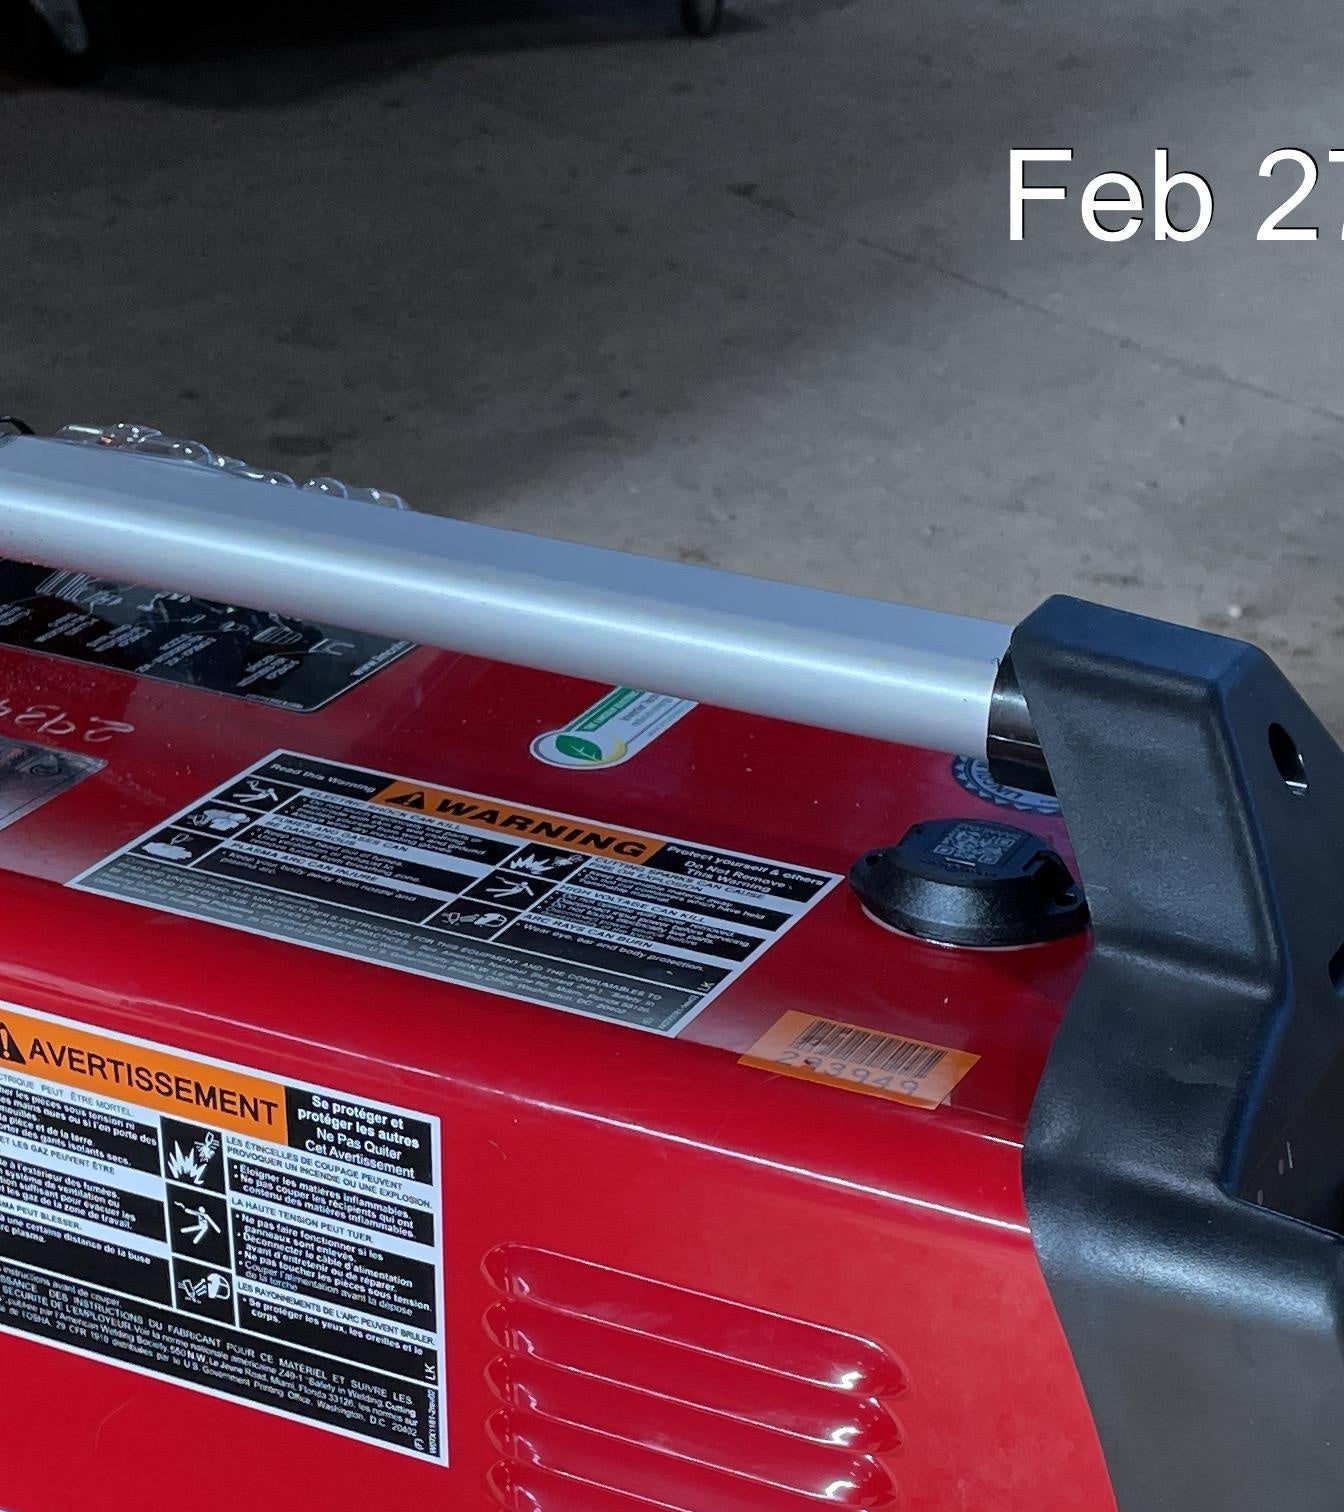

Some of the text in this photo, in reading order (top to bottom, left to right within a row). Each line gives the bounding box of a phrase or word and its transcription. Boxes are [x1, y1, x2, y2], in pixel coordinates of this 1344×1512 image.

[429, 798, 652, 857] WARNING
[712, 856, 769, 874] yourself
[713, 875, 772, 893] Warning
[730, 871, 788, 888] Remove
[26, 1035, 279, 1128] AVERTISSEMENT
[297, 1105, 419, 1149] protéger les autres
[332, 1100, 387, 1128] protéger
[316, 1126, 333, 1142] Ne
[337, 1132, 360, 1150] Pas
[305, 1138, 414, 1179] Cet Avertissement
